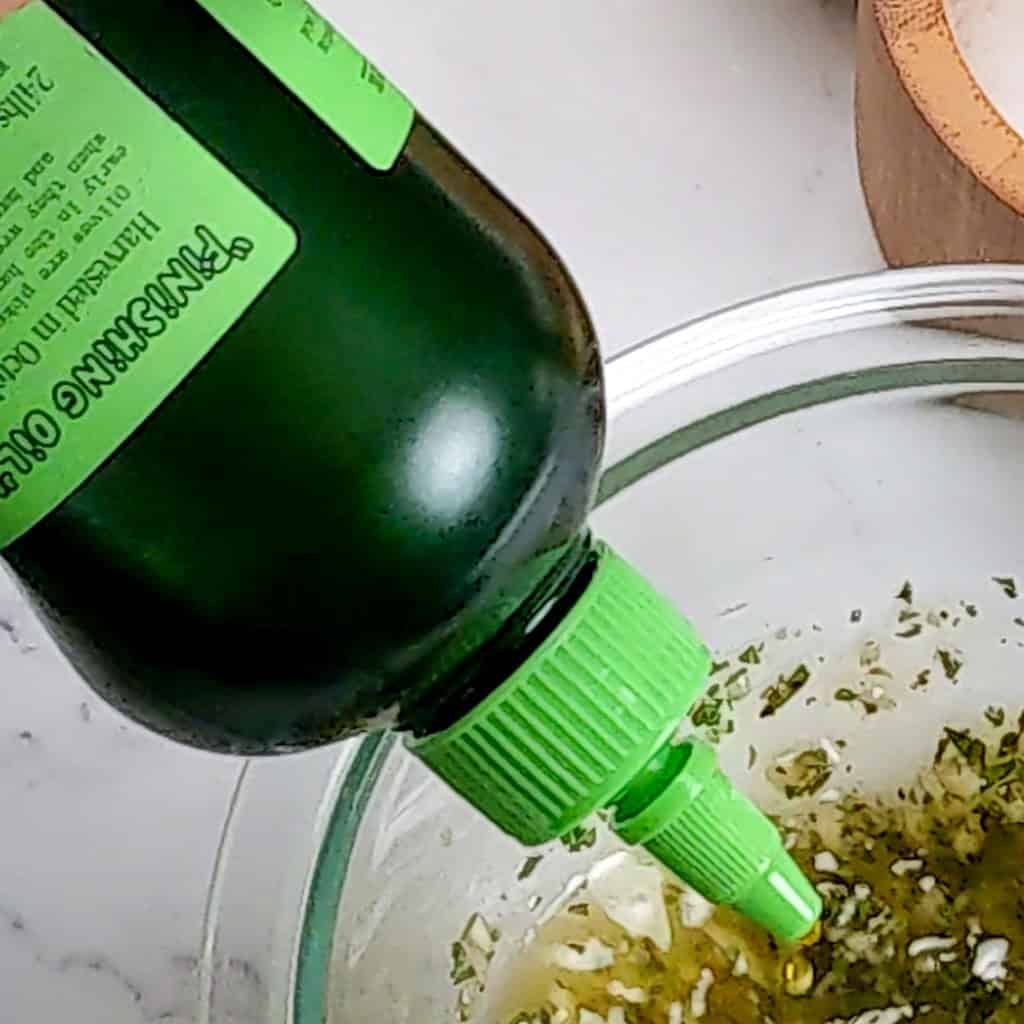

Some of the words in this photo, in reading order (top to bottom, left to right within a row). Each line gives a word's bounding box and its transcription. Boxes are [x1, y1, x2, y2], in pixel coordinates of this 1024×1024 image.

[22, 152, 54, 187] and
[67, 133, 107, 173] when
[83, 145, 127, 196] early
[27, 180, 66, 218] they
[57, 200, 81, 222] in
[73, 184, 131, 243] Olives
[56, 211, 161, 321] Harvested
[31, 313, 67, 341] in
